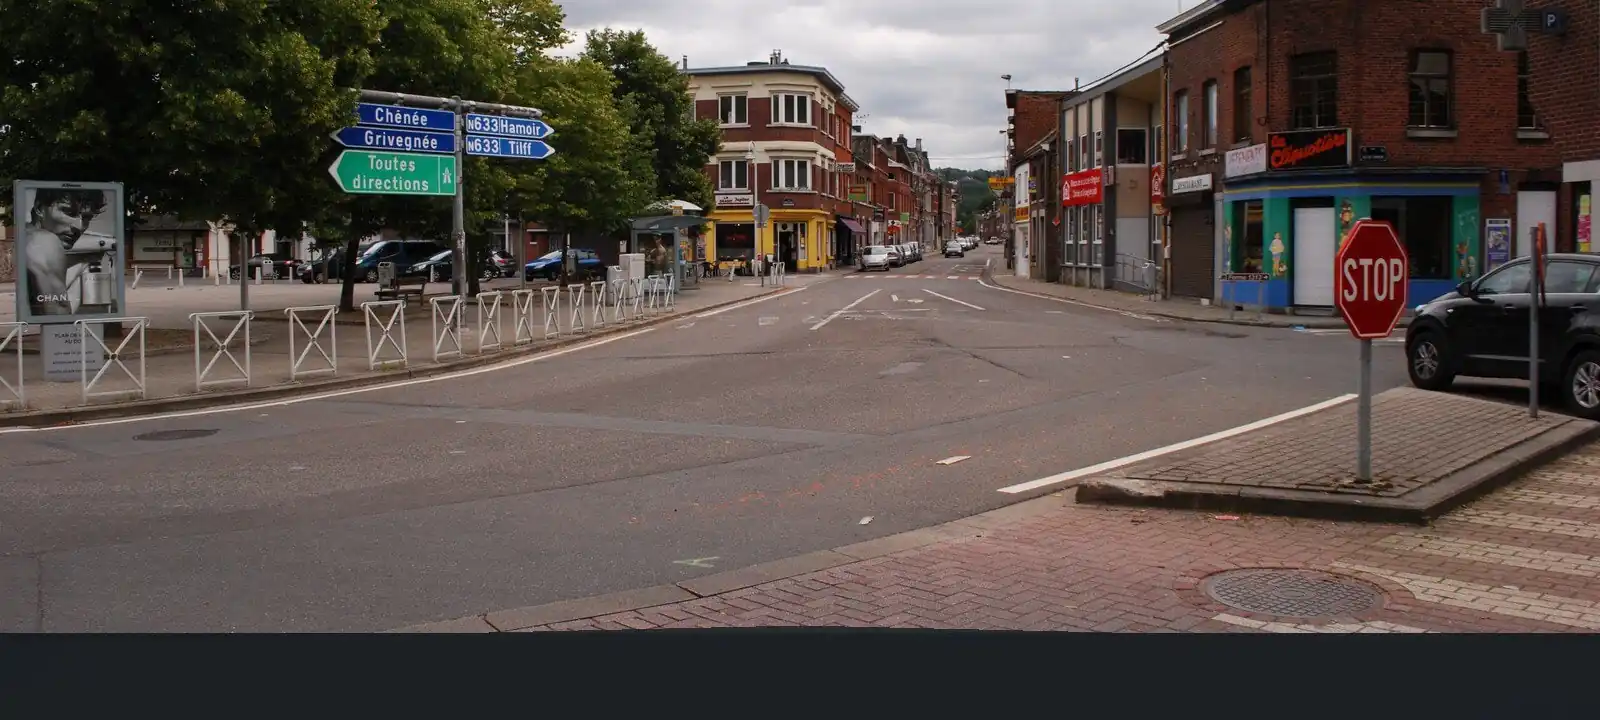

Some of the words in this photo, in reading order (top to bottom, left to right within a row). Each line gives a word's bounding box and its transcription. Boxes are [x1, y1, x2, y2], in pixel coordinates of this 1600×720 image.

[1547, 14, 1557, 27] P
[375, 107, 428, 126] Chênée
[467, 116, 499, 132] N633
[500, 121, 541, 136] Hamoir
[364, 131, 438, 151] Grivegnée
[467, 138, 499, 153] N633
[508, 140, 533, 155] Tilff
[367, 155, 416, 172] Toutes
[352, 174, 429, 192] directions
[1343, 258, 1403, 302] STOP
